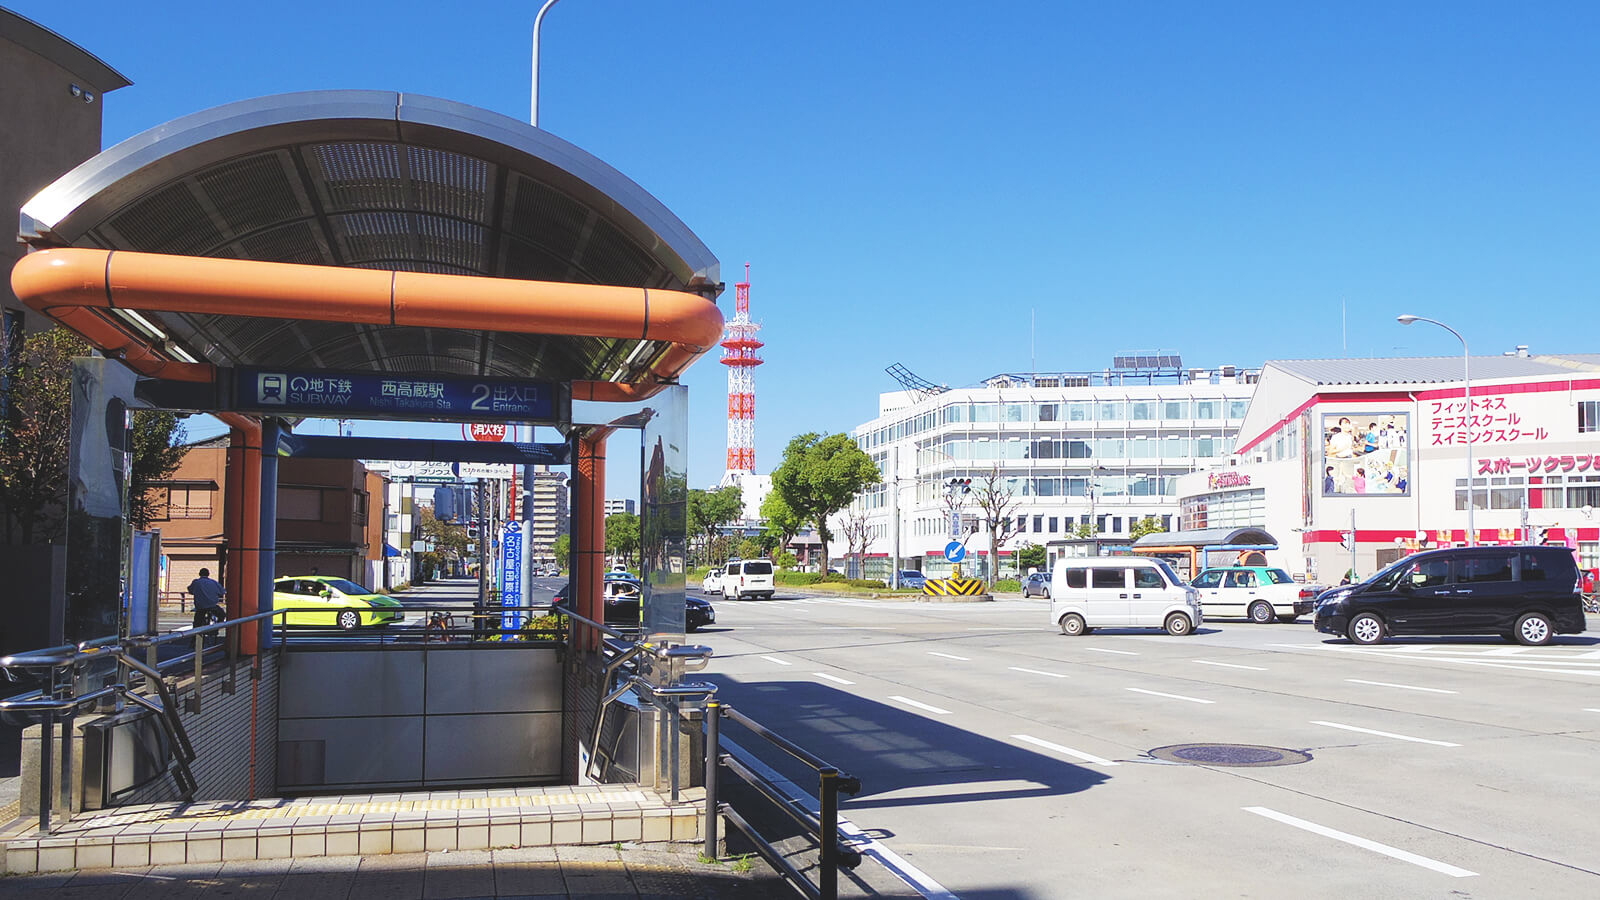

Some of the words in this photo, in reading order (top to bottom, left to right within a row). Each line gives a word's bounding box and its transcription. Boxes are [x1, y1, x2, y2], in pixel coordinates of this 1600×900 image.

[310, 378, 352, 393] 地下鉄
[381, 380, 444, 398] 西高蔵駅
[493, 385, 537, 402] 出入口
[290, 392, 351, 405] SUBWAY
[369, 396, 392, 407] Nishi
[396, 397, 434, 408] Takakura
[471, 383, 490, 410] 2
[492, 401, 529, 412] Entranc
[1432, 397, 1507, 415] フィットネス
[473, 423, 504, 436] 消火栓
[1432, 412, 1521, 430] テニススクール
[1432, 427, 1549, 446] スイミングスクール
